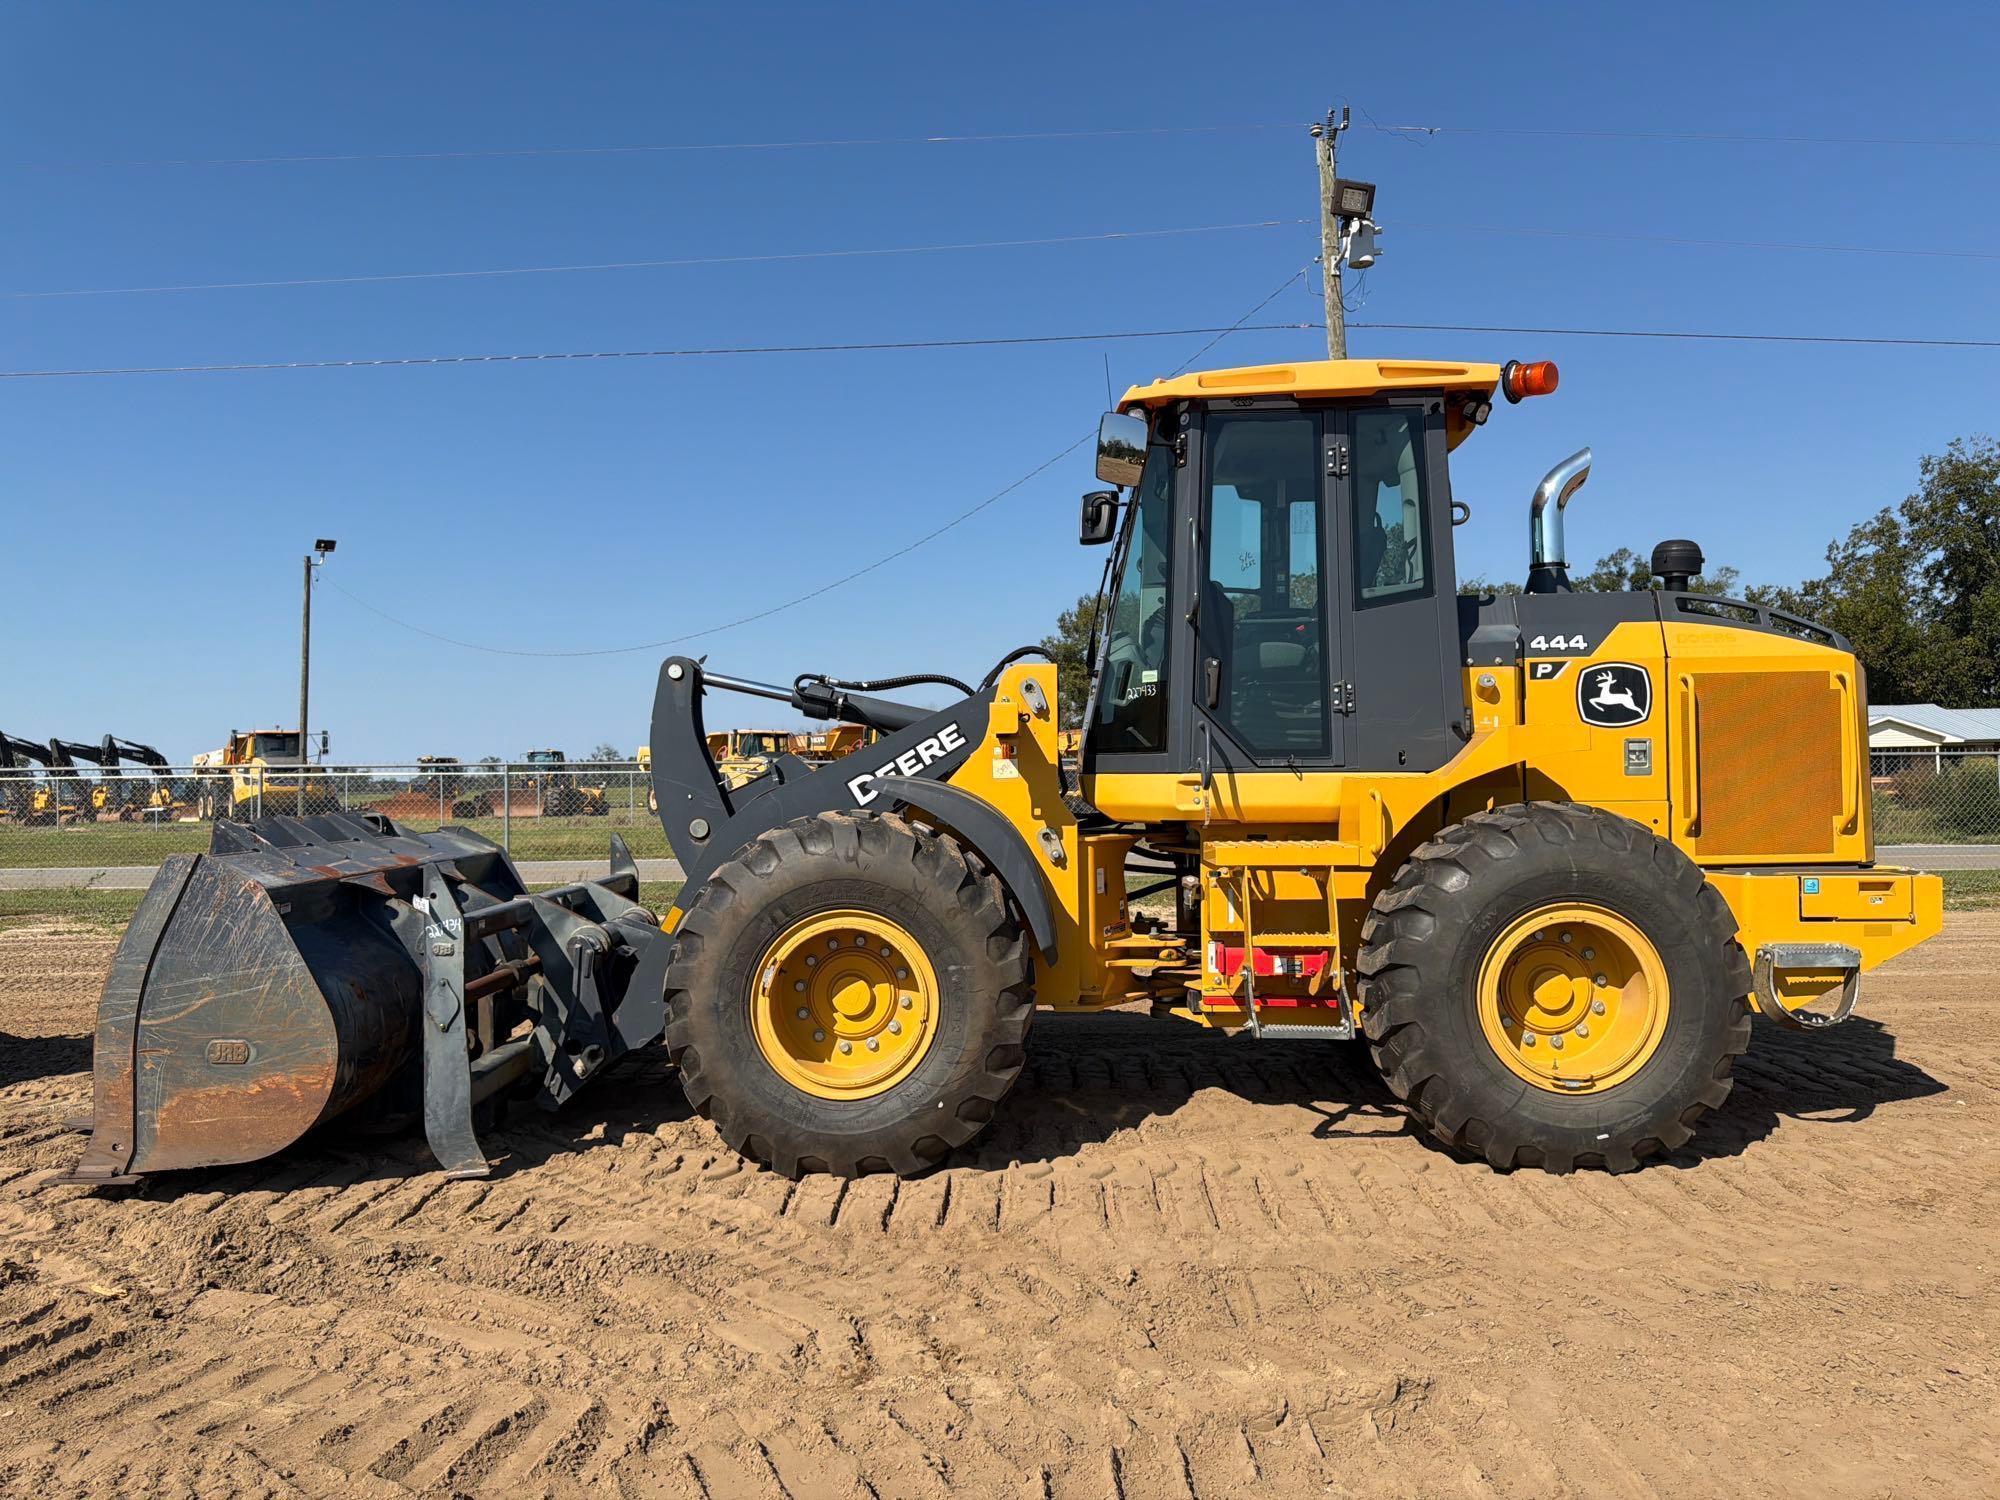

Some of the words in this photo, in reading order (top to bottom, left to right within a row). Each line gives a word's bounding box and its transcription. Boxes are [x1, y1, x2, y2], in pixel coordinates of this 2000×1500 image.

[1530, 634, 1588, 651] 444
[1536, 663, 1553, 678] P
[1127, 684, 1157, 700] 227433
[209, 1043, 247, 1062] JRB
